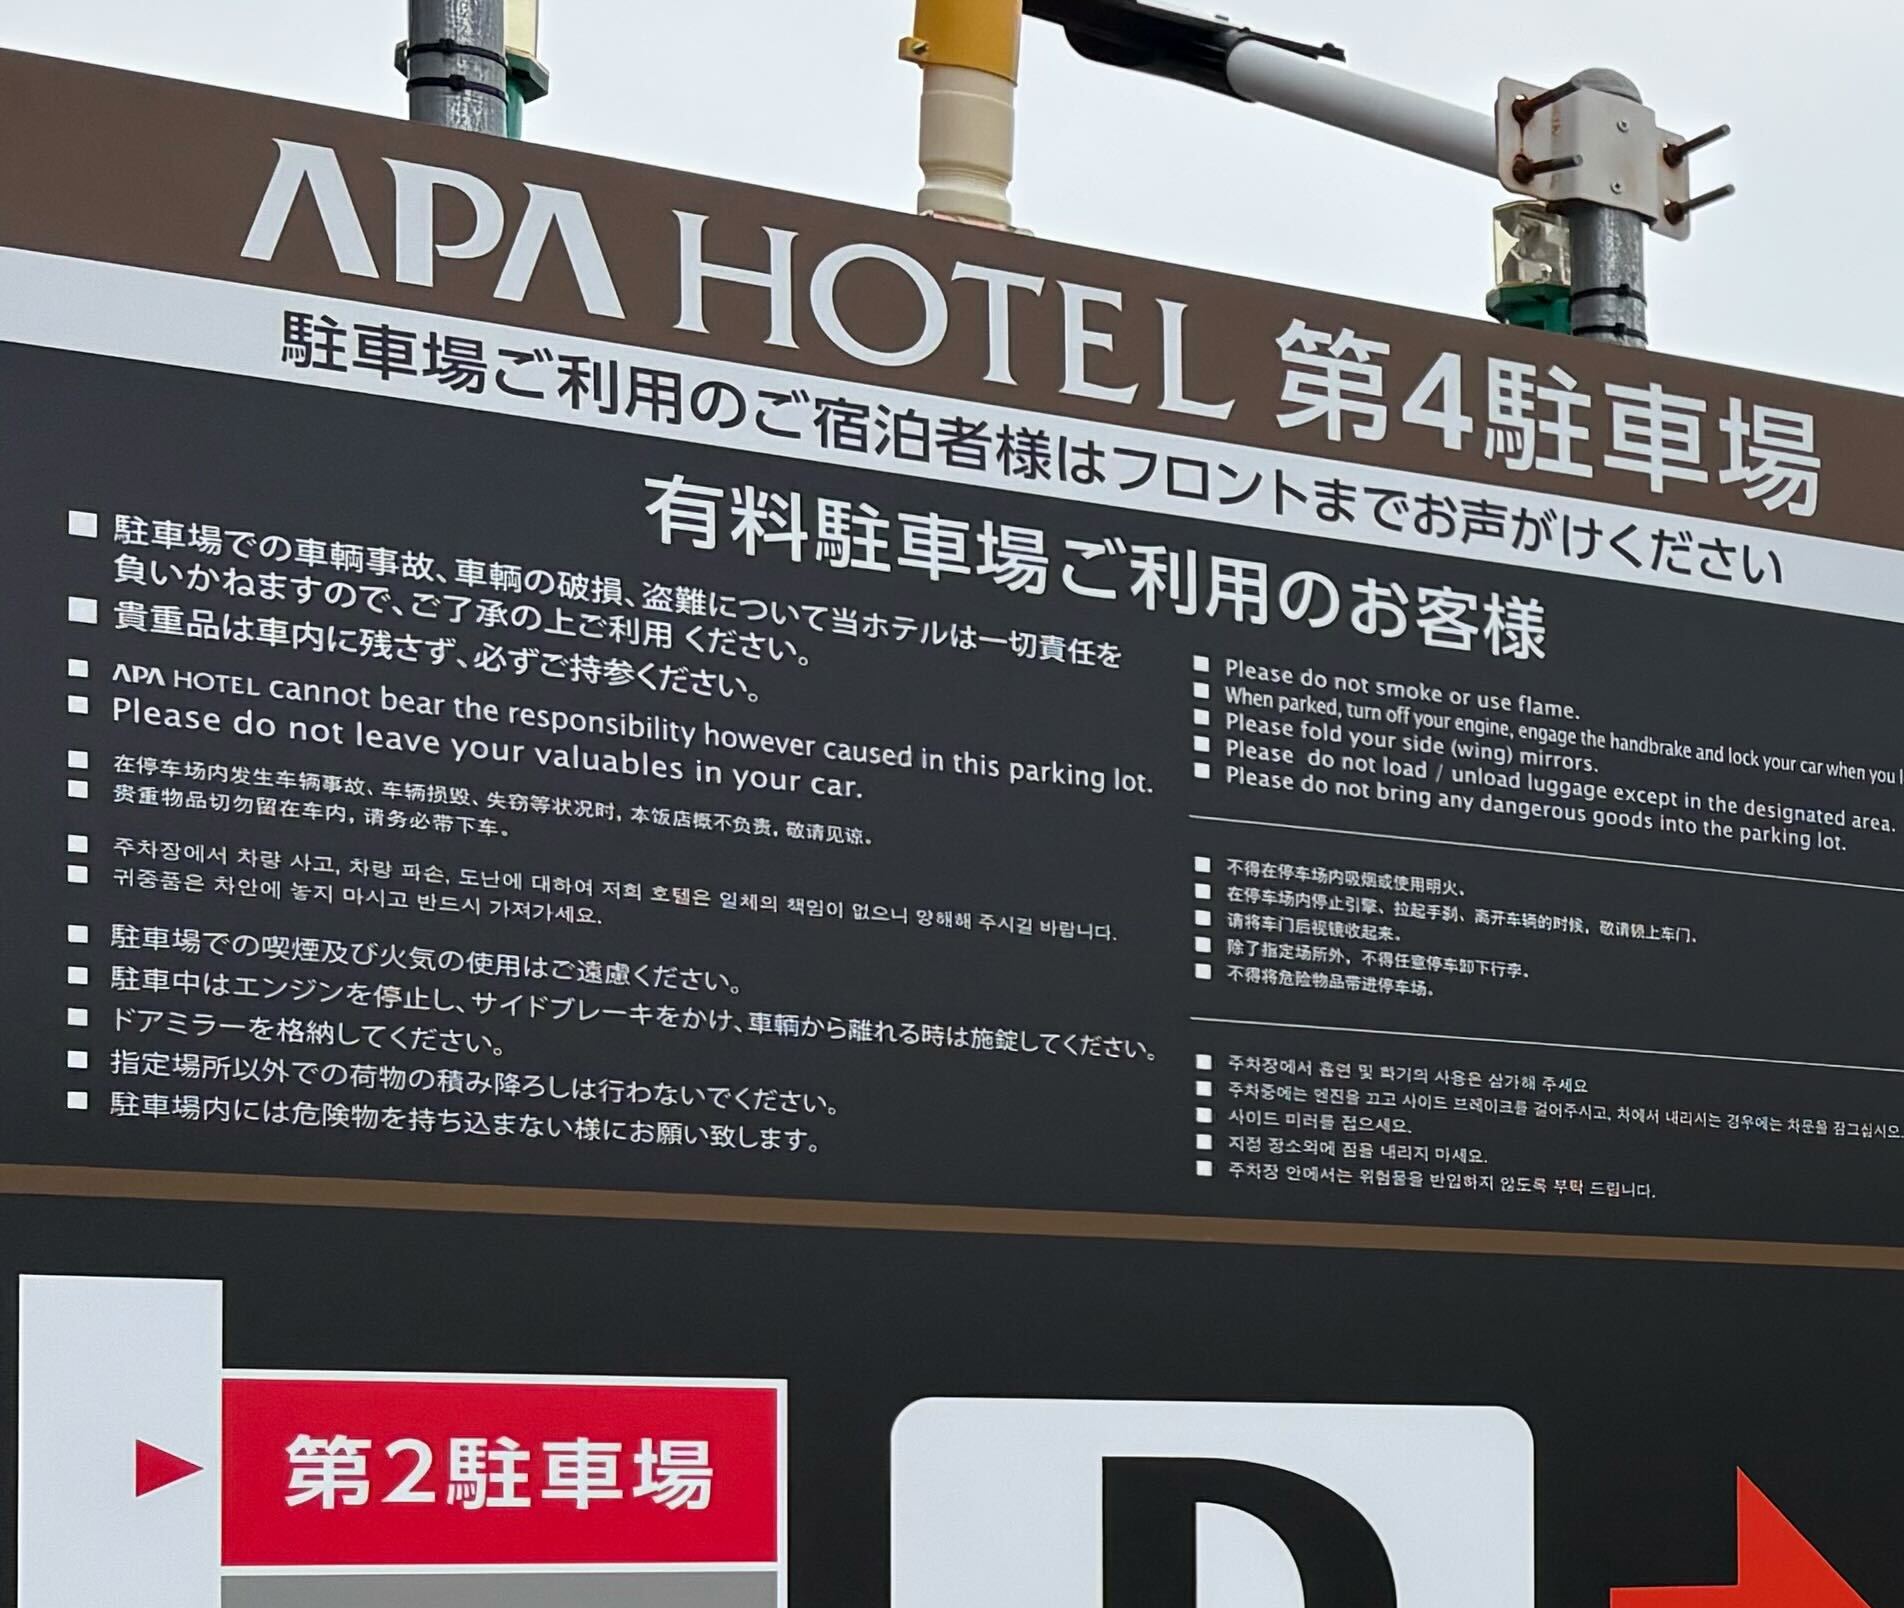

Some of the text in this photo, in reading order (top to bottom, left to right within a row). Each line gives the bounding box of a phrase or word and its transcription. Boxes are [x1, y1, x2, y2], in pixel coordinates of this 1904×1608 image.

[240, 137, 1821, 517] APA HOTEL 第4駐車場
[644, 474, 1546, 660] 有料駐車場ご利用のお客様
[113, 600, 759, 703] 貴重品は車内に残さず、必ずご持参ください。
[1225, 658, 1580, 720] Please do not smoke or use flame.
[112, 663, 1153, 794] APA HOTEL cannot bear the responsibility however caused in this parking lot.
[113, 696, 863, 799] Please do not leave your valuables in your car.
[1224, 685, 1274, 709] When
[1278, 694, 1342, 719] parked,
[1346, 702, 1382, 721] turn
[1385, 705, 1411, 725] off
[1412, 712, 1452, 730] your
[1454, 717, 1514, 740] engine,
[1517, 725, 1577, 748] engage
[1580, 728, 1606, 749] the
[1609, 731, 1692, 759] handbrake
[1695, 745, 1724, 763] and
[1728, 746, 1760, 767] lock
[1762, 755, 1797, 772] your
[1799, 760, 1824, 775] car
[1825, 760, 1866, 781] when
[1868, 768, 1896, 785] you
[1225, 711, 1599, 773] Please fold your side (wing) mirrors.
[1226, 738, 1896, 833] Please do not load / unload luggage except in the designated area.
[1226, 765, 1847, 851] Please do not bring any dangerous goods into the parking lot.
[113, 837, 1117, 942] 주차장에서 차량 사고, 차량 파손, 도난에 대하여 저희 호텔은 일체의 책임이 없으니 양해해 주시길 바랍니다.
[113, 867, 602, 925] 귀중품은 차안에 놓지 마시고 반드시 가져가세요.
[110, 923, 739, 995] 駐車場での喫煙及び火気の使用はご遠慮ください。
[116, 1007, 503, 1057] ドアミラーを格納してください。
[285, 1433, 713, 1510] 第2駐車場
